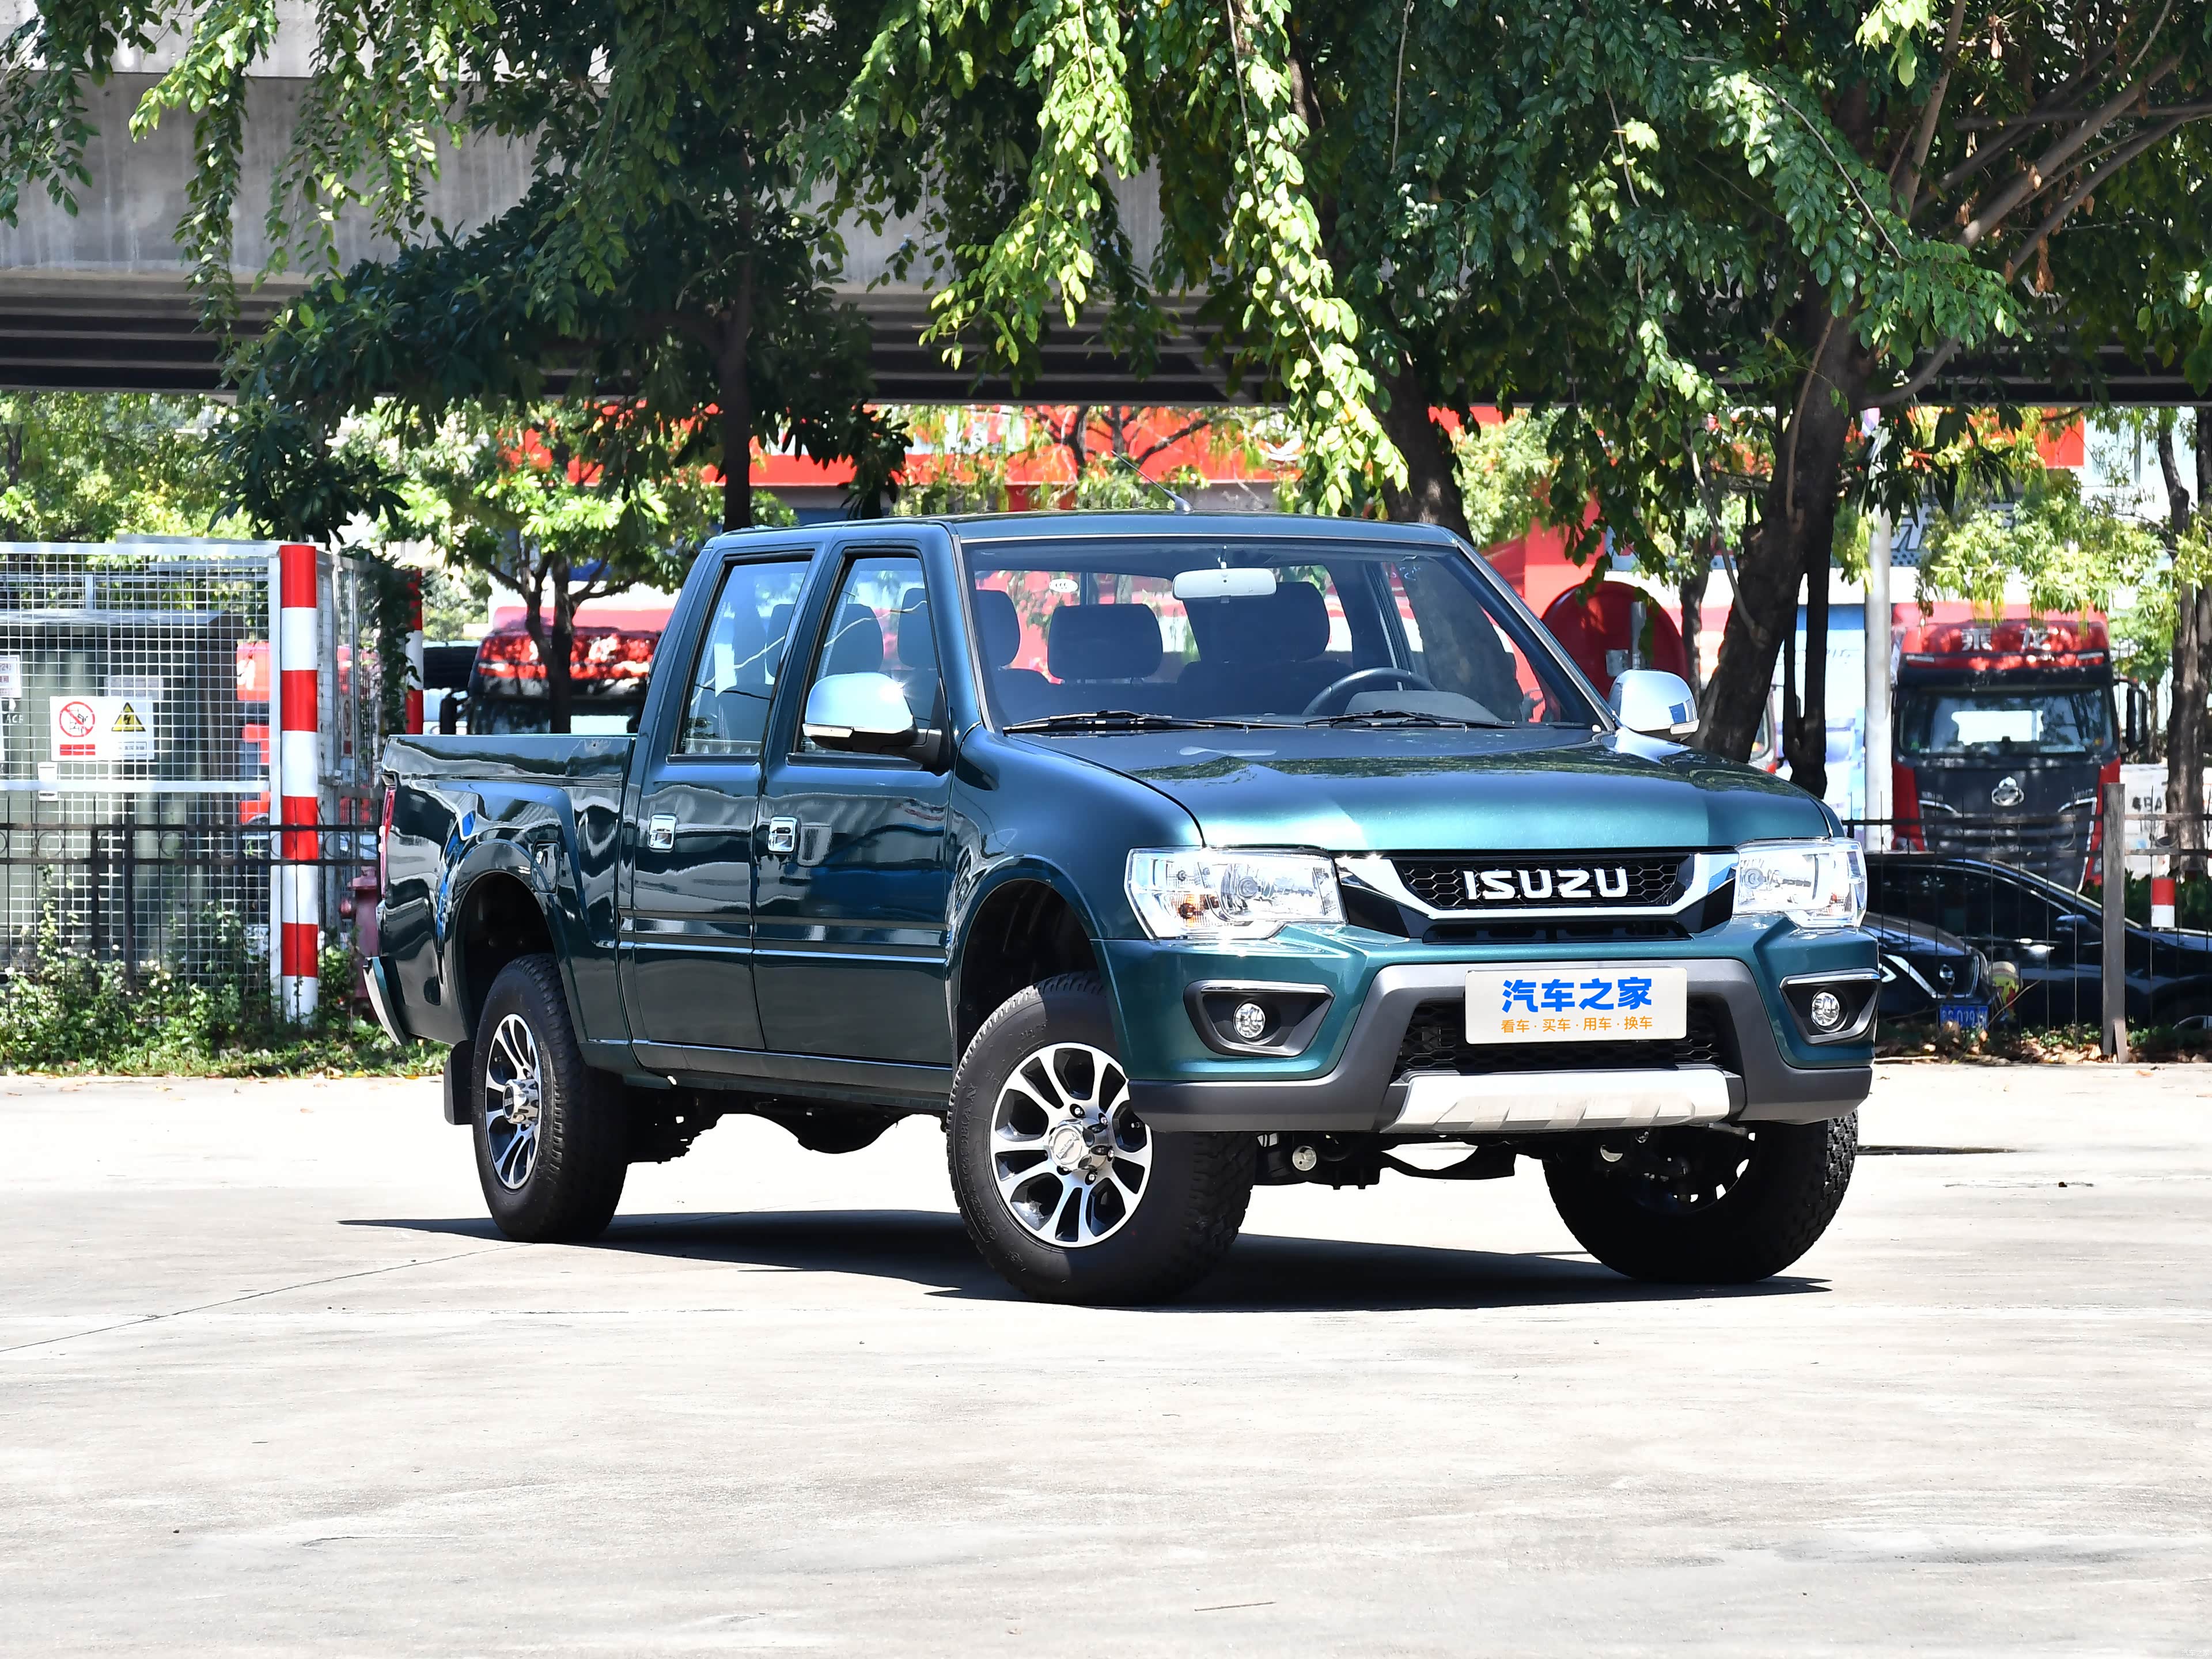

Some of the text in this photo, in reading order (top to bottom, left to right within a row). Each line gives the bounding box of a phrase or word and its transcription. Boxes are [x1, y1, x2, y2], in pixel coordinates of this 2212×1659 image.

[1463, 868, 1628, 900] ISUZU
[1501, 977, 1652, 1013] 汽车之家
